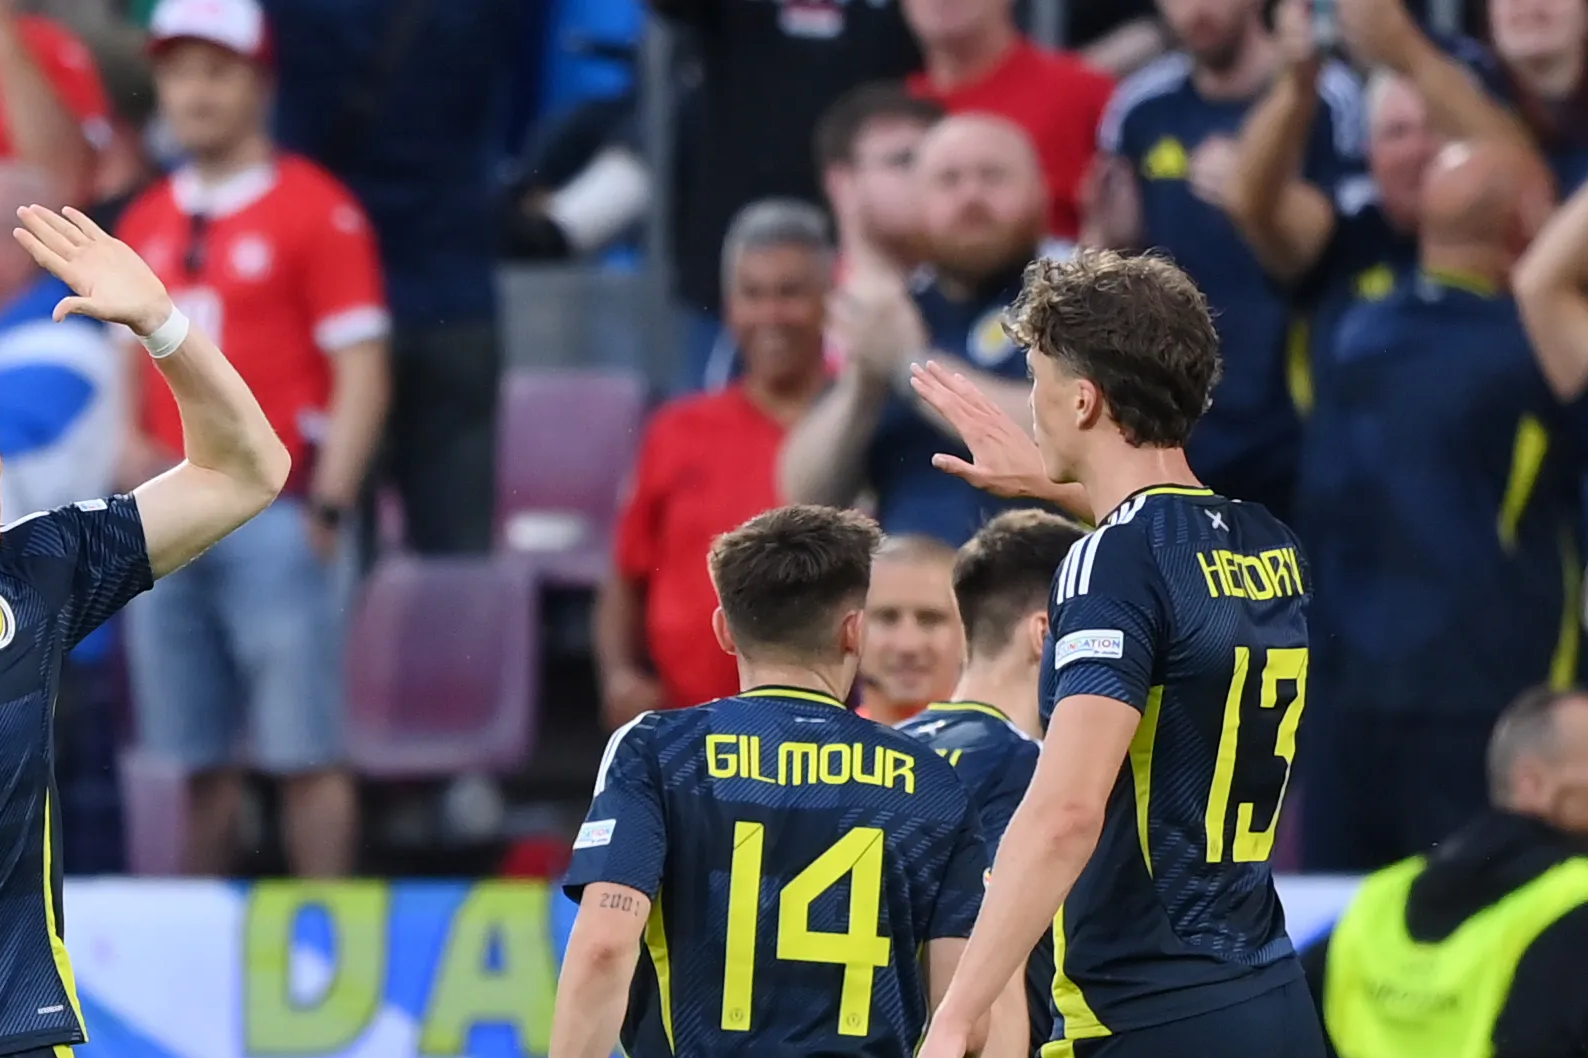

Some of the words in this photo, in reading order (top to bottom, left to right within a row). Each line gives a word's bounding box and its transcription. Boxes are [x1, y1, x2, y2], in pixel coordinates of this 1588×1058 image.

[705, 733, 915, 794] GILMOUR
[1205, 646, 1309, 863] 13
[598, 892, 641, 918] 2001
[720, 820, 891, 1037] 14
